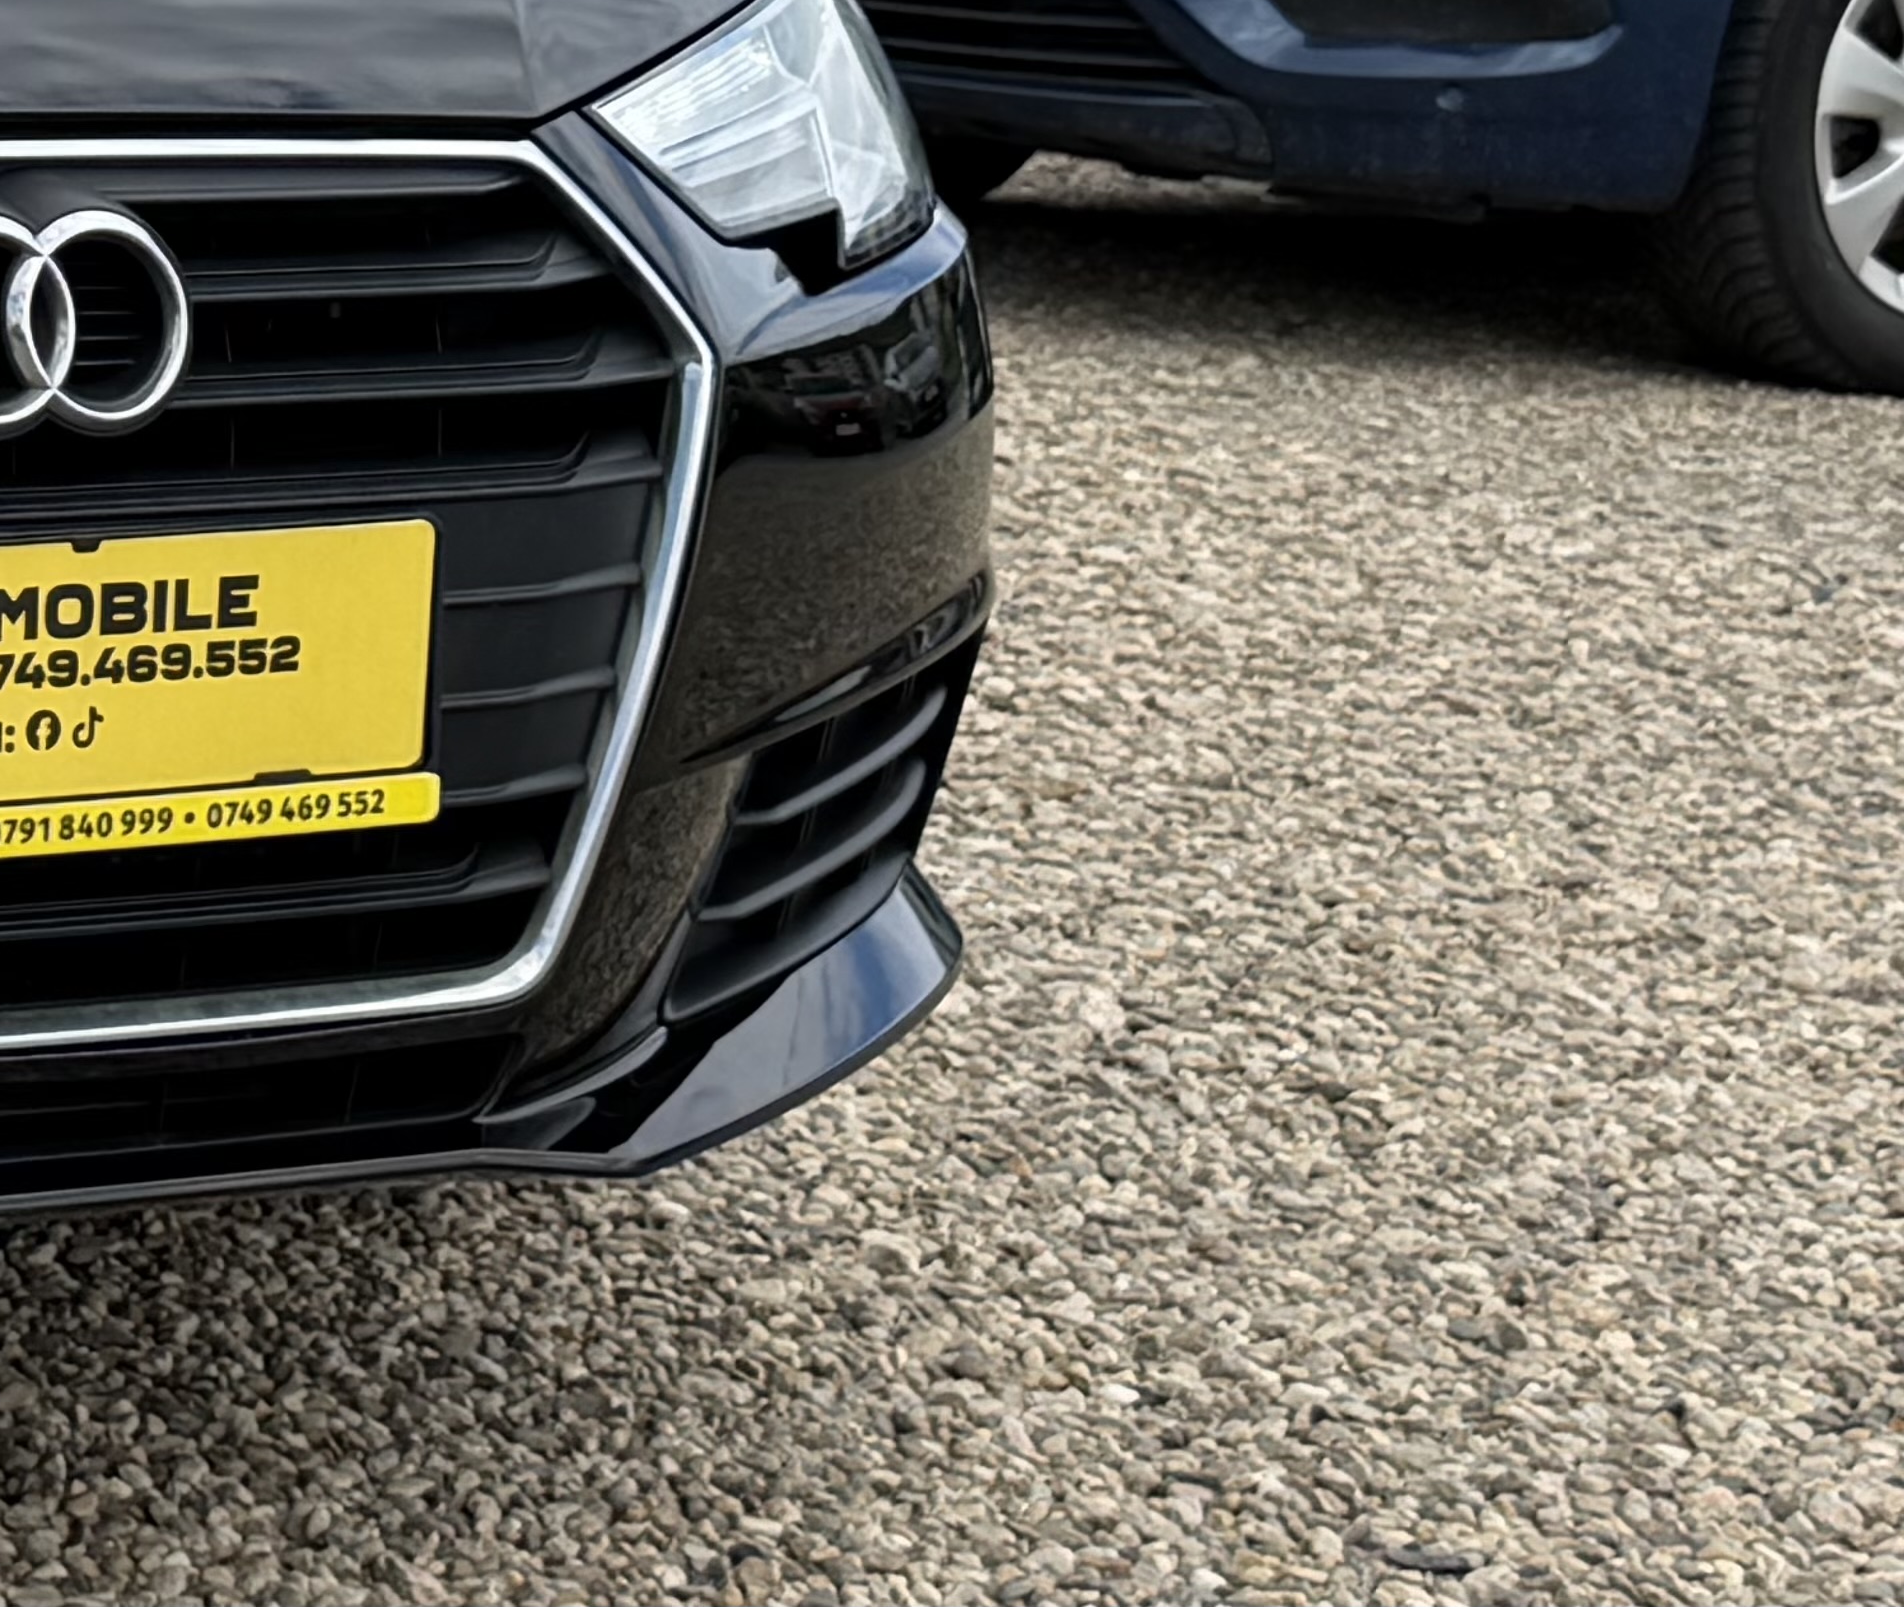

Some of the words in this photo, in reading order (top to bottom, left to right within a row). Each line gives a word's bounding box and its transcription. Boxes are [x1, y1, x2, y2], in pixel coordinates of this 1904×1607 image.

[58, 812, 113, 841] 840
[120, 807, 174, 836] 999
[206, 798, 273, 829] 0749
[279, 793, 331, 822] 469
[337, 789, 385, 818] 552
